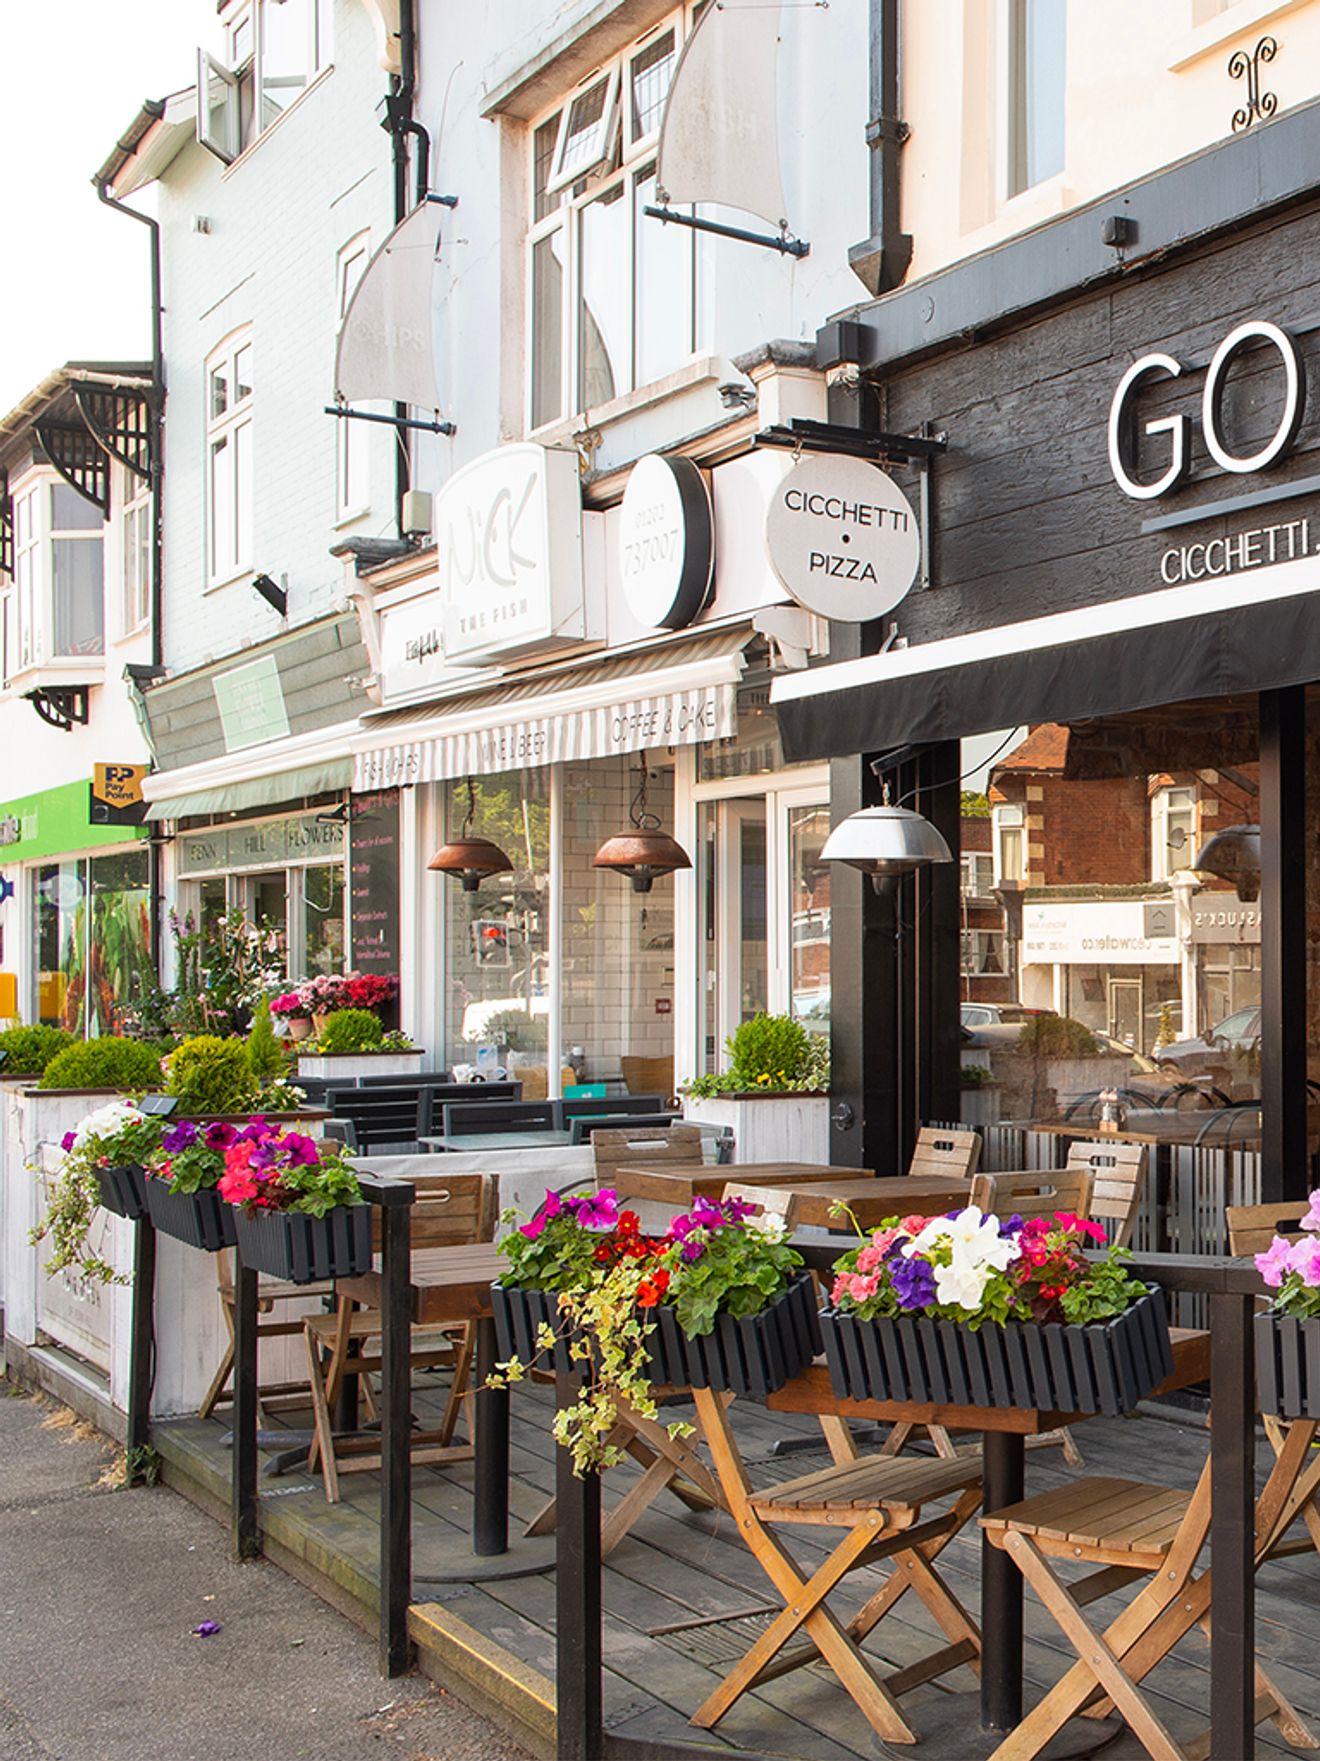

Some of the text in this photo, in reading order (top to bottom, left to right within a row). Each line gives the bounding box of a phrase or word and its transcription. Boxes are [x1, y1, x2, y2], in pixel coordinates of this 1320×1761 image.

[785, 490, 908, 532] CICCHETTI
[624, 530, 680, 578] 737007
[810, 552, 878, 584] PIZZA
[460, 598, 528, 634] THE FISH
[612, 701, 716, 742] COFFEE & CAKE
[105, 782, 125, 793] Pay
[105, 791, 135, 800] Point
[190, 842, 217, 861] PENN
[244, 835, 267, 854] HILL
[288, 825, 344, 848] FLOWERS
